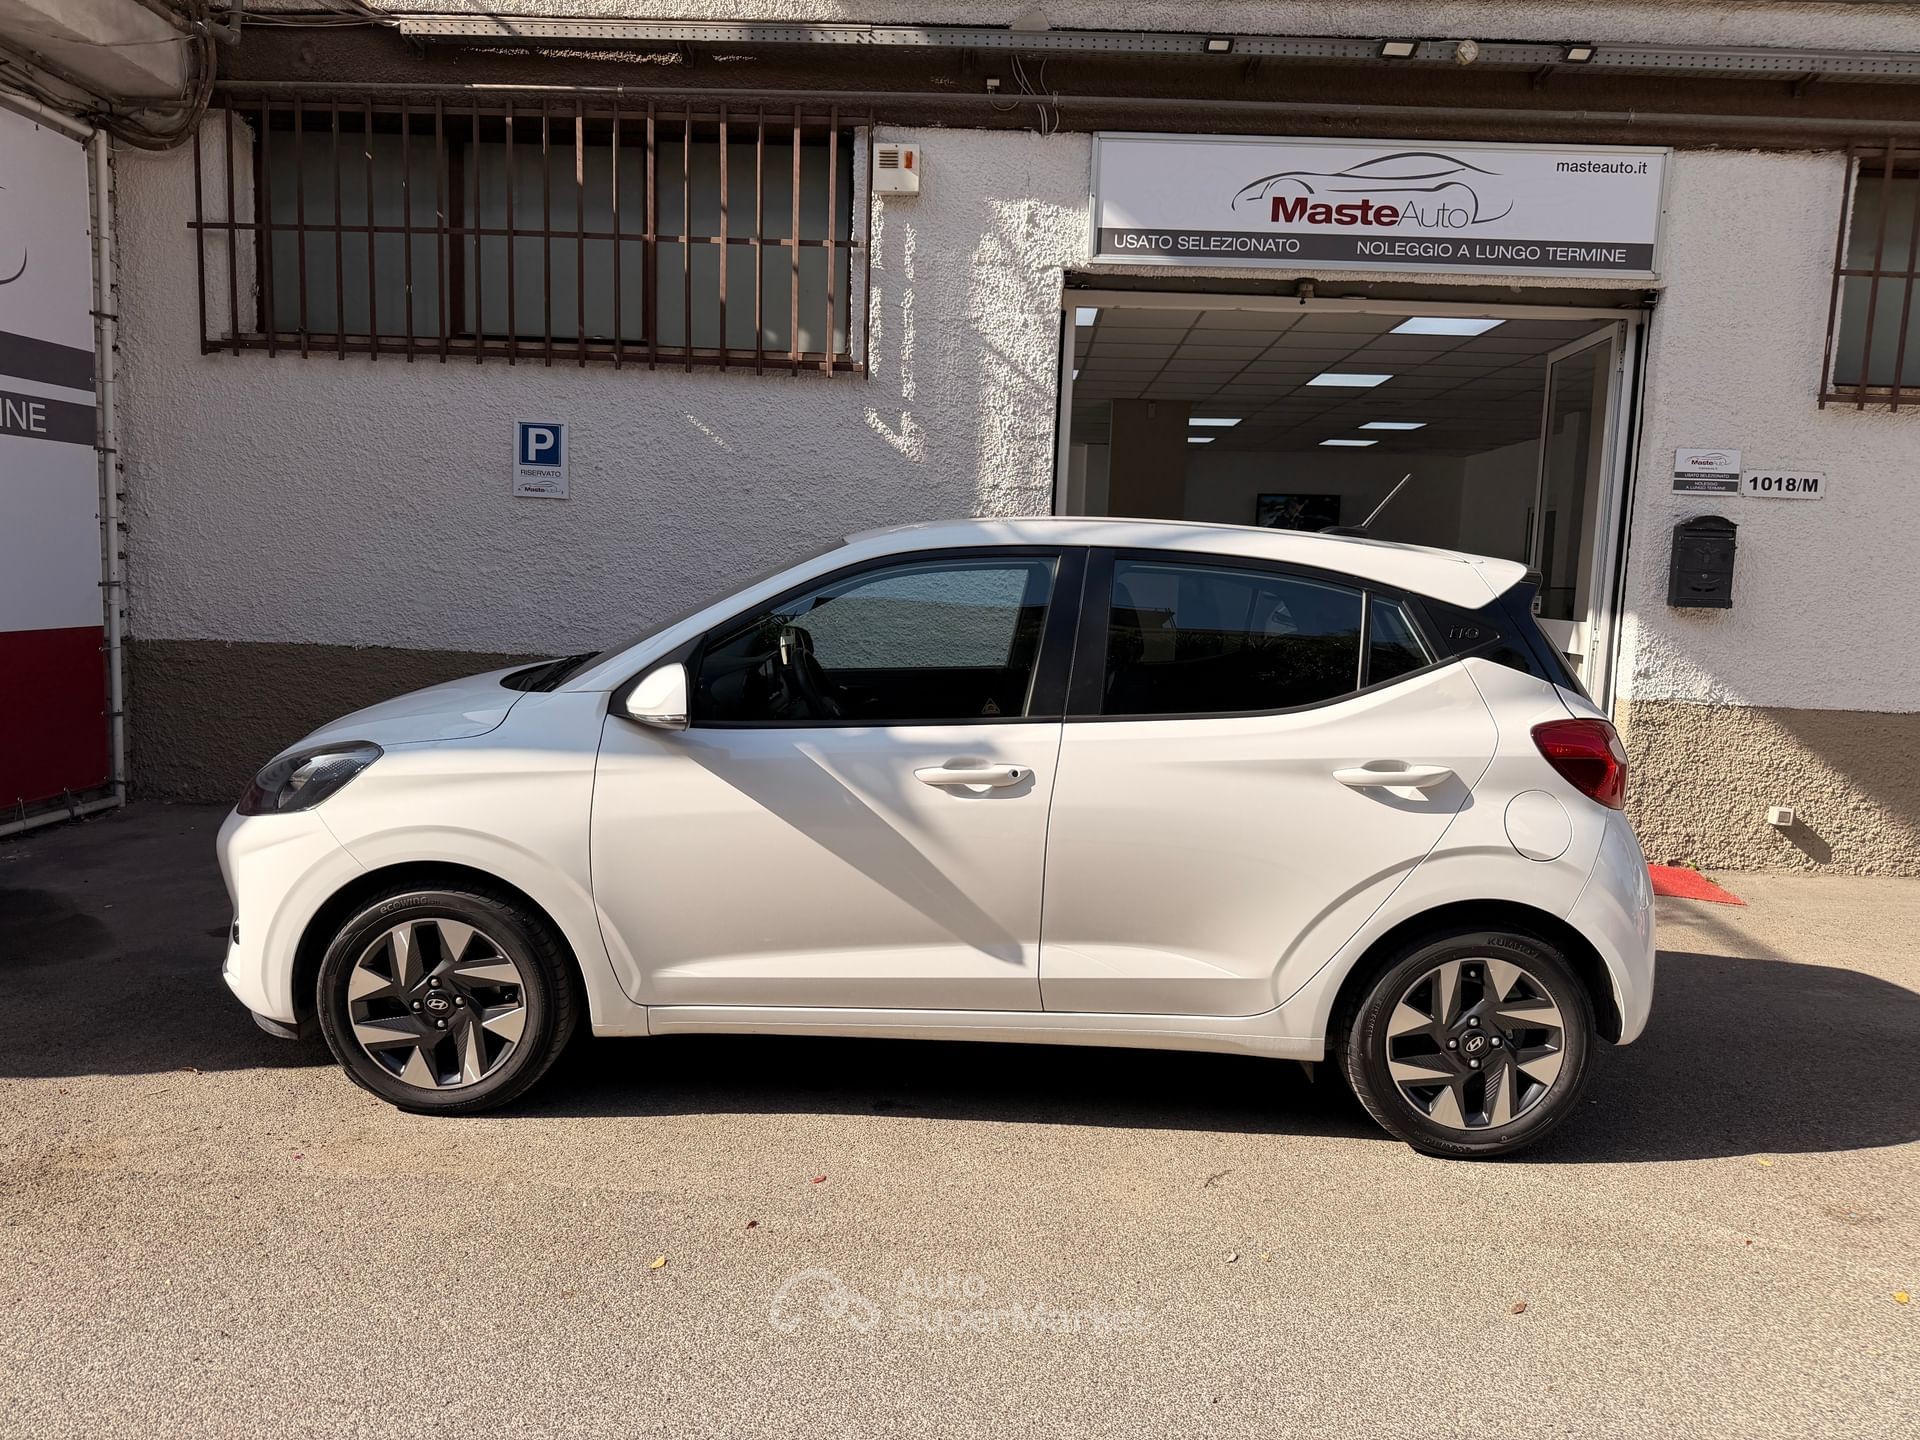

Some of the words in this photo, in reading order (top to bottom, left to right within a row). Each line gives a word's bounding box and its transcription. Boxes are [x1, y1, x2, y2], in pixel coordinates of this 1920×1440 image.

[1556, 160, 1648, 175] masteauto.it
[1271, 196, 1469, 229] MasteAuto
[1114, 234, 1173, 250] USATO
[1177, 235, 1301, 253] SELEZIONATO
[1356, 240, 1453, 258] NOLEGGIO
[1457, 243, 1471, 258] A
[1475, 244, 1541, 261] LUNGO
[1545, 246, 1627, 263] TERMINE
[527, 427, 555, 461] P
[520, 469, 562, 478] RISERVATO
[1749, 476, 1819, 493] 1018/M
